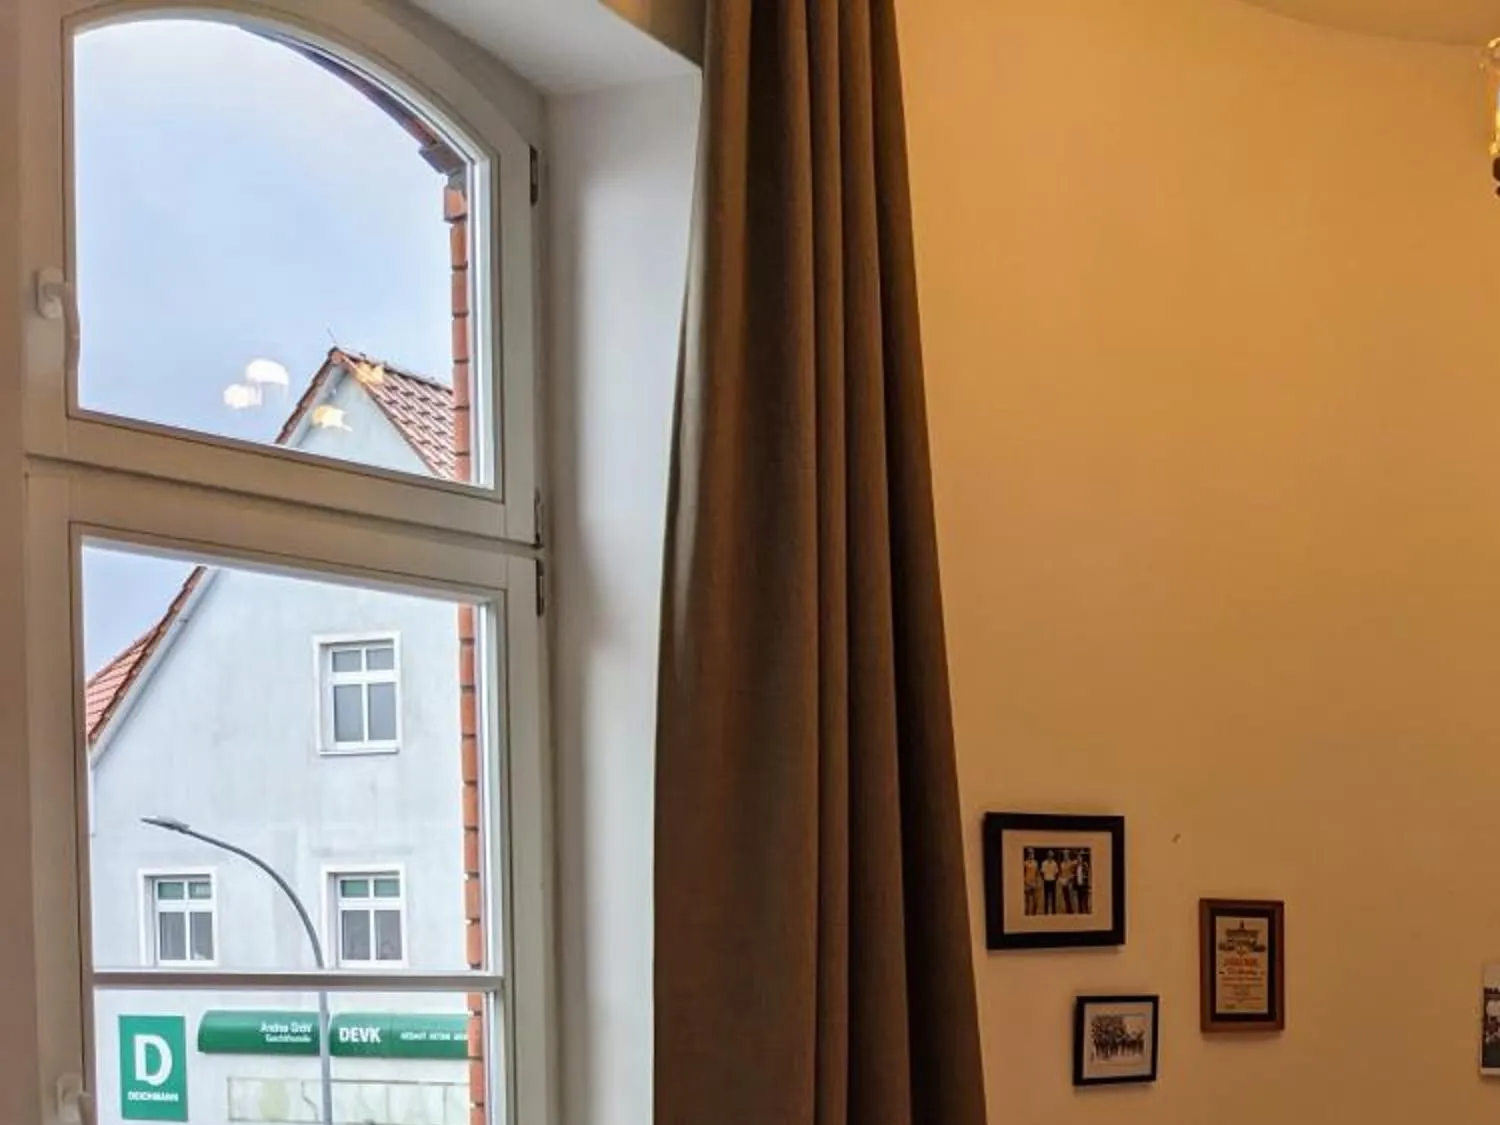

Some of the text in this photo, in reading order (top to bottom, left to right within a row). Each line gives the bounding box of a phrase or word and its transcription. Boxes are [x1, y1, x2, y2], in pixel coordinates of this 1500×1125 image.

[339, 1027, 381, 1043] DEVK
[134, 1034, 173, 1086] D
[127, 1091, 179, 1102] DEICHMANN
